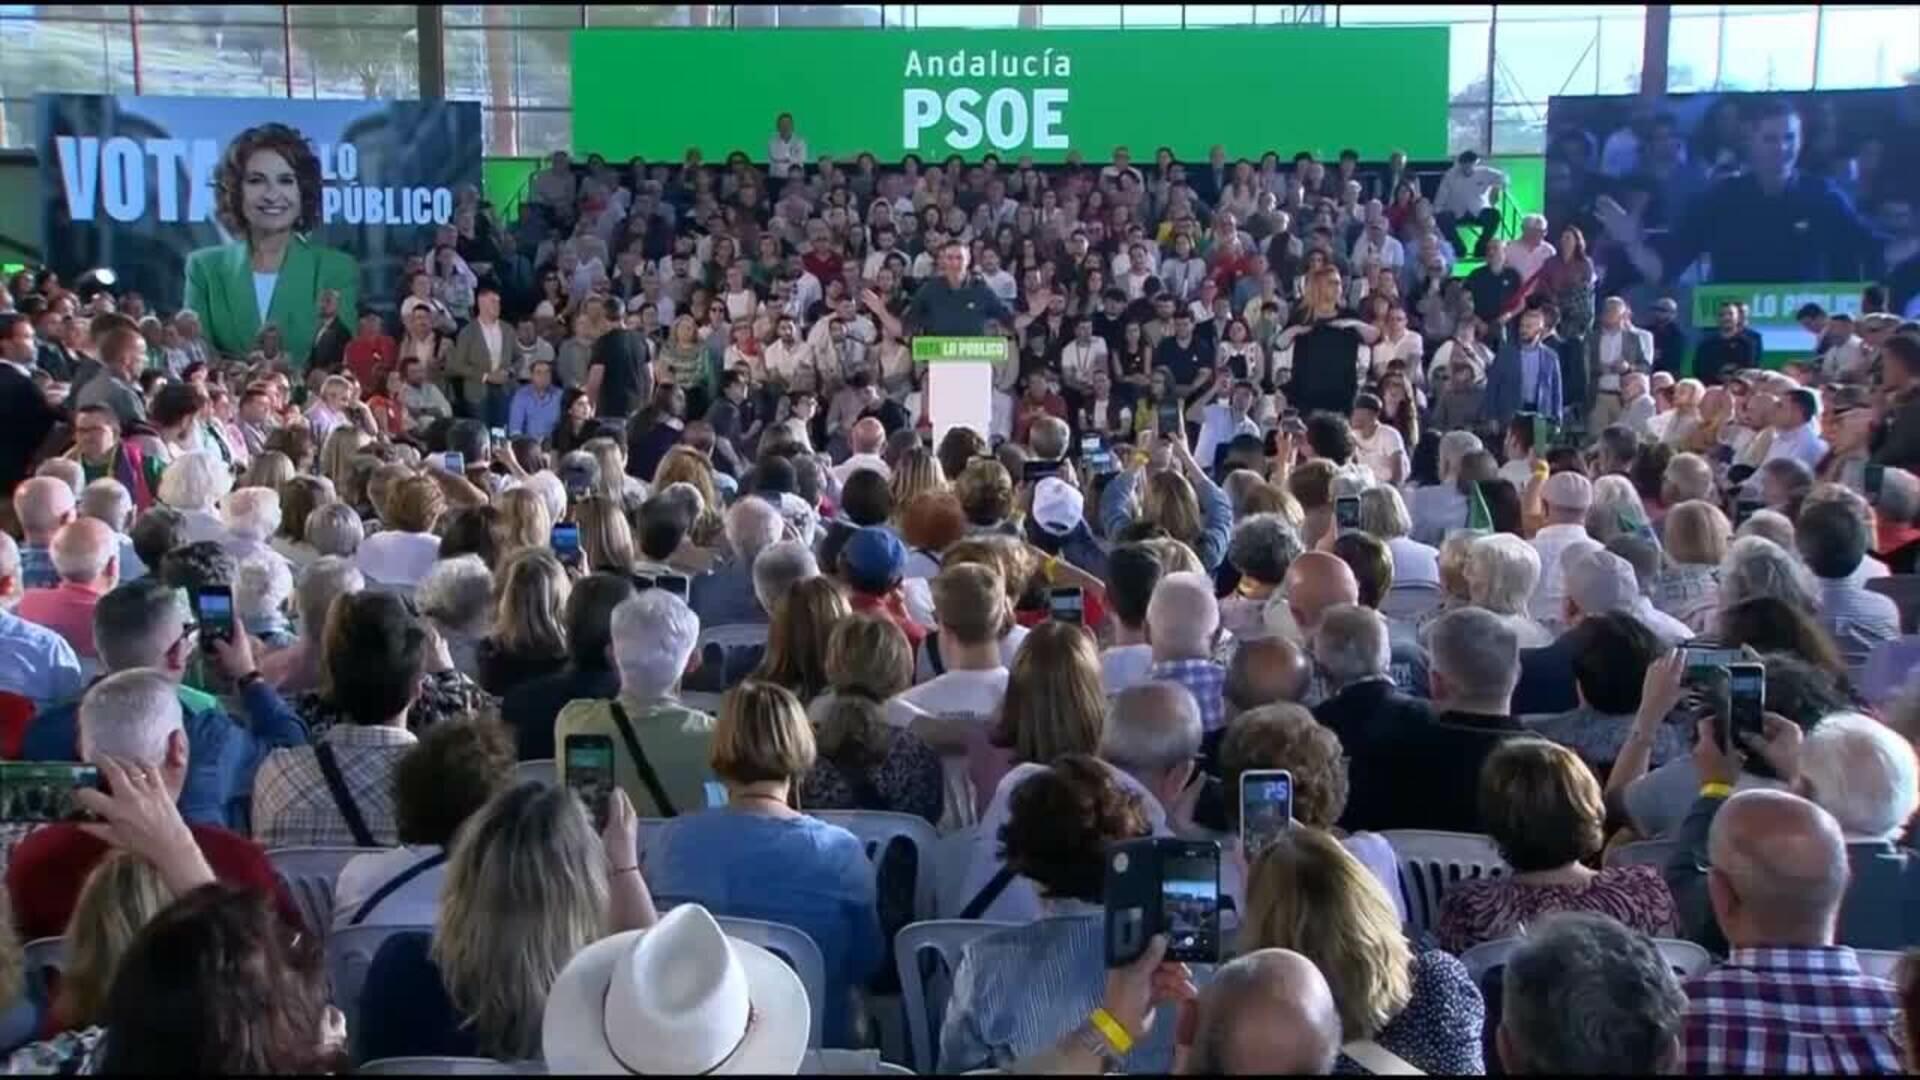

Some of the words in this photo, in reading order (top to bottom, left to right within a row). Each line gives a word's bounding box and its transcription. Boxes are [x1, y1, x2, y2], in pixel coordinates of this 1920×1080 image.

[904, 48, 1071, 77] Andalucía
[903, 87, 1069, 150] PSOE
[321, 142, 358, 181] LO
[322, 182, 453, 225] PÚBLICO
[943, 342, 957, 356] LO
